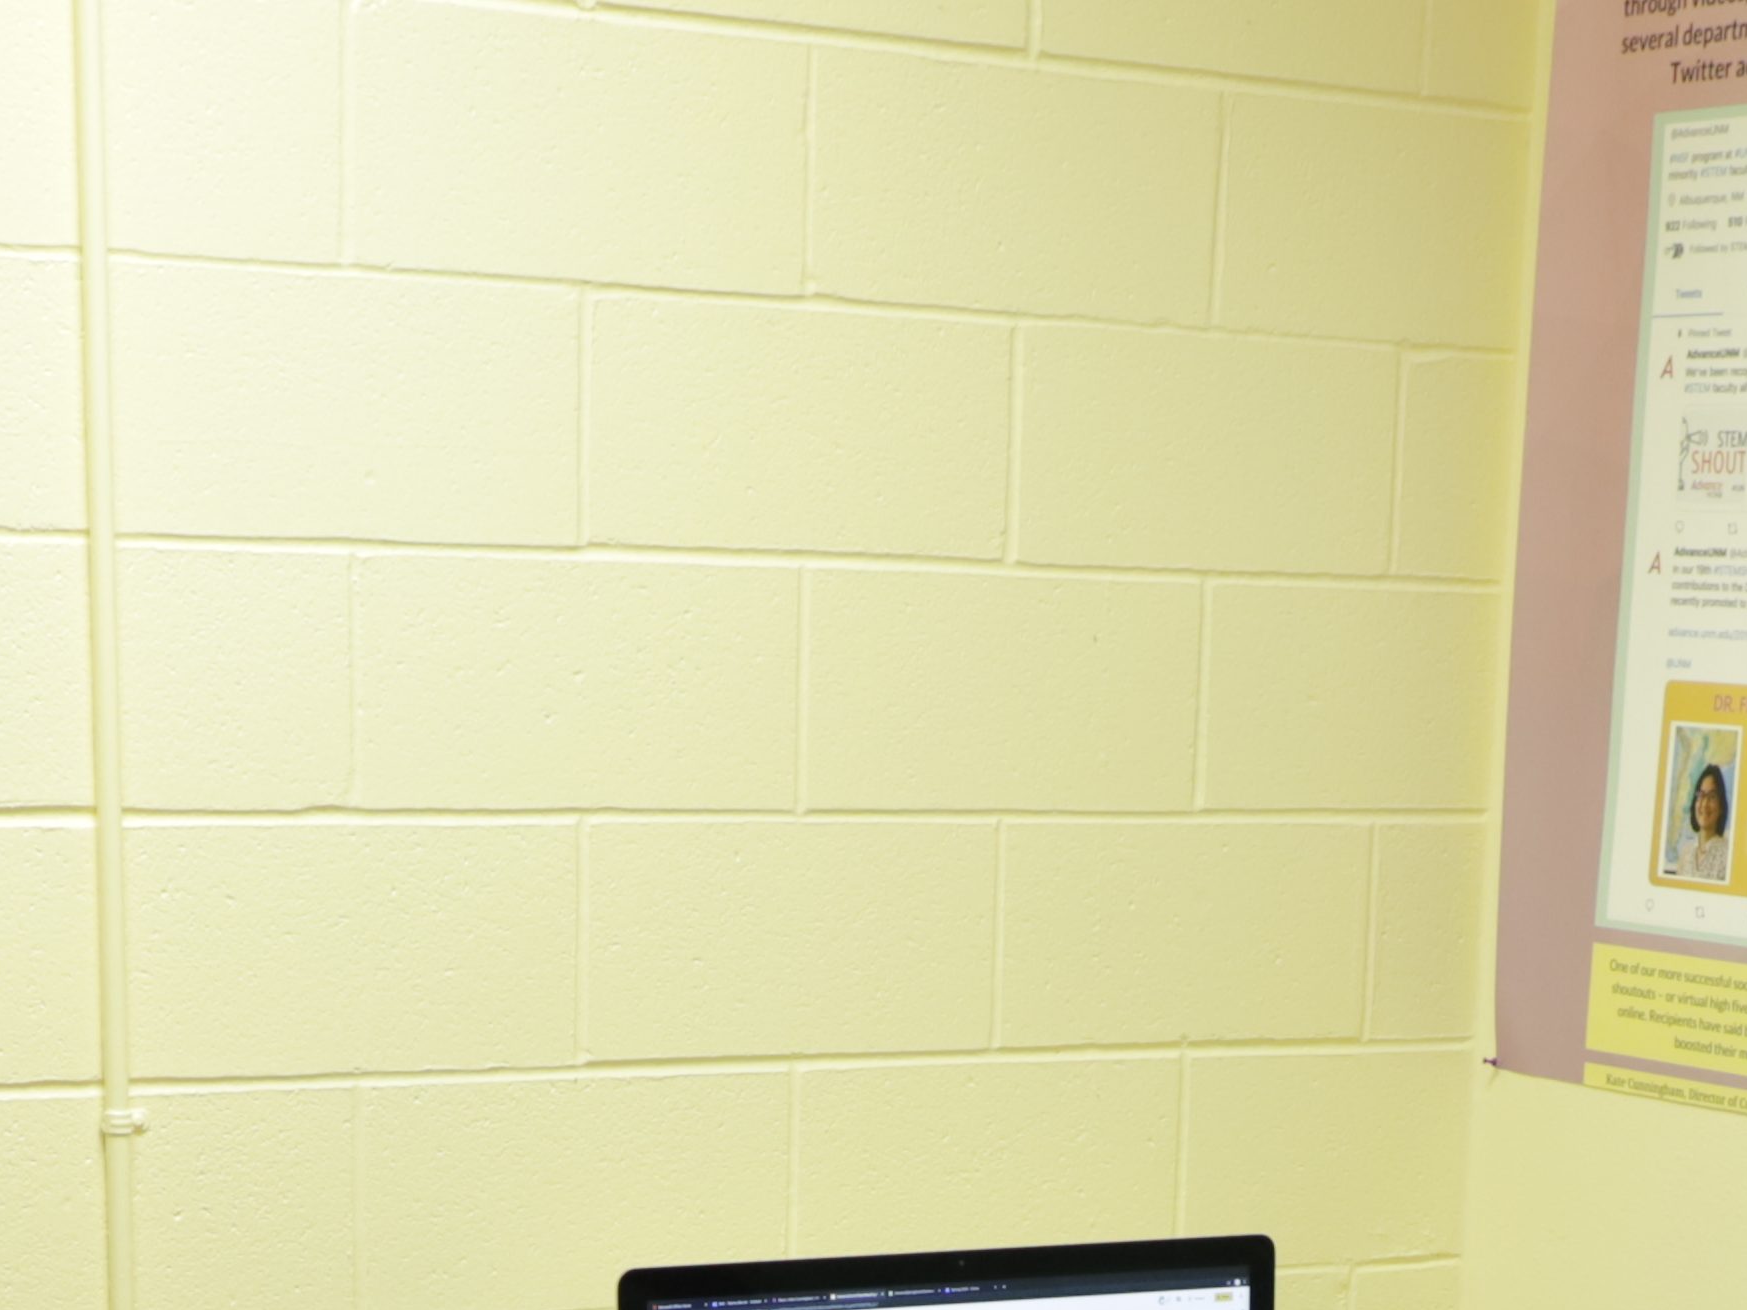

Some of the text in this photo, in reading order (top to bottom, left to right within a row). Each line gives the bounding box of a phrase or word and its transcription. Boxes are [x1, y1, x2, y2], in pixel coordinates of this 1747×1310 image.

[1621, 32, 1678, 53] several
[1671, 62, 1730, 83] Twitter
[1717, 431, 1747, 448] STEM
[1691, 450, 1746, 474] SHOUT
[1713, 695, 1735, 713] DR.
[1609, 960, 1628, 974] One
[1629, 963, 1639, 975] of
[1640, 967, 1655, 978] our
[1657, 970, 1681, 981] more
[1683, 973, 1731, 989] successful
[1612, 984, 1656, 1001] shoutouts
[1664, 994, 1675, 1004] or
[1676, 993, 1707, 1009] virtual
[1709, 997, 1729, 1014] high
[1617, 1008, 1646, 1023] online.
[1648, 1012, 1696, 1030] Recipients
[1698, 1019, 1721, 1034] have
[1723, 1024, 1742, 1037] said
[1674, 1037, 1712, 1054] boosted
[1714, 1044, 1736, 1059] their
[1606, 1074, 1625, 1089] Kate
[1627, 1077, 1686, 1102] Cunningham,
[1688, 1088, 1725, 1107] Director
[1727, 1096, 1737, 1109] of
